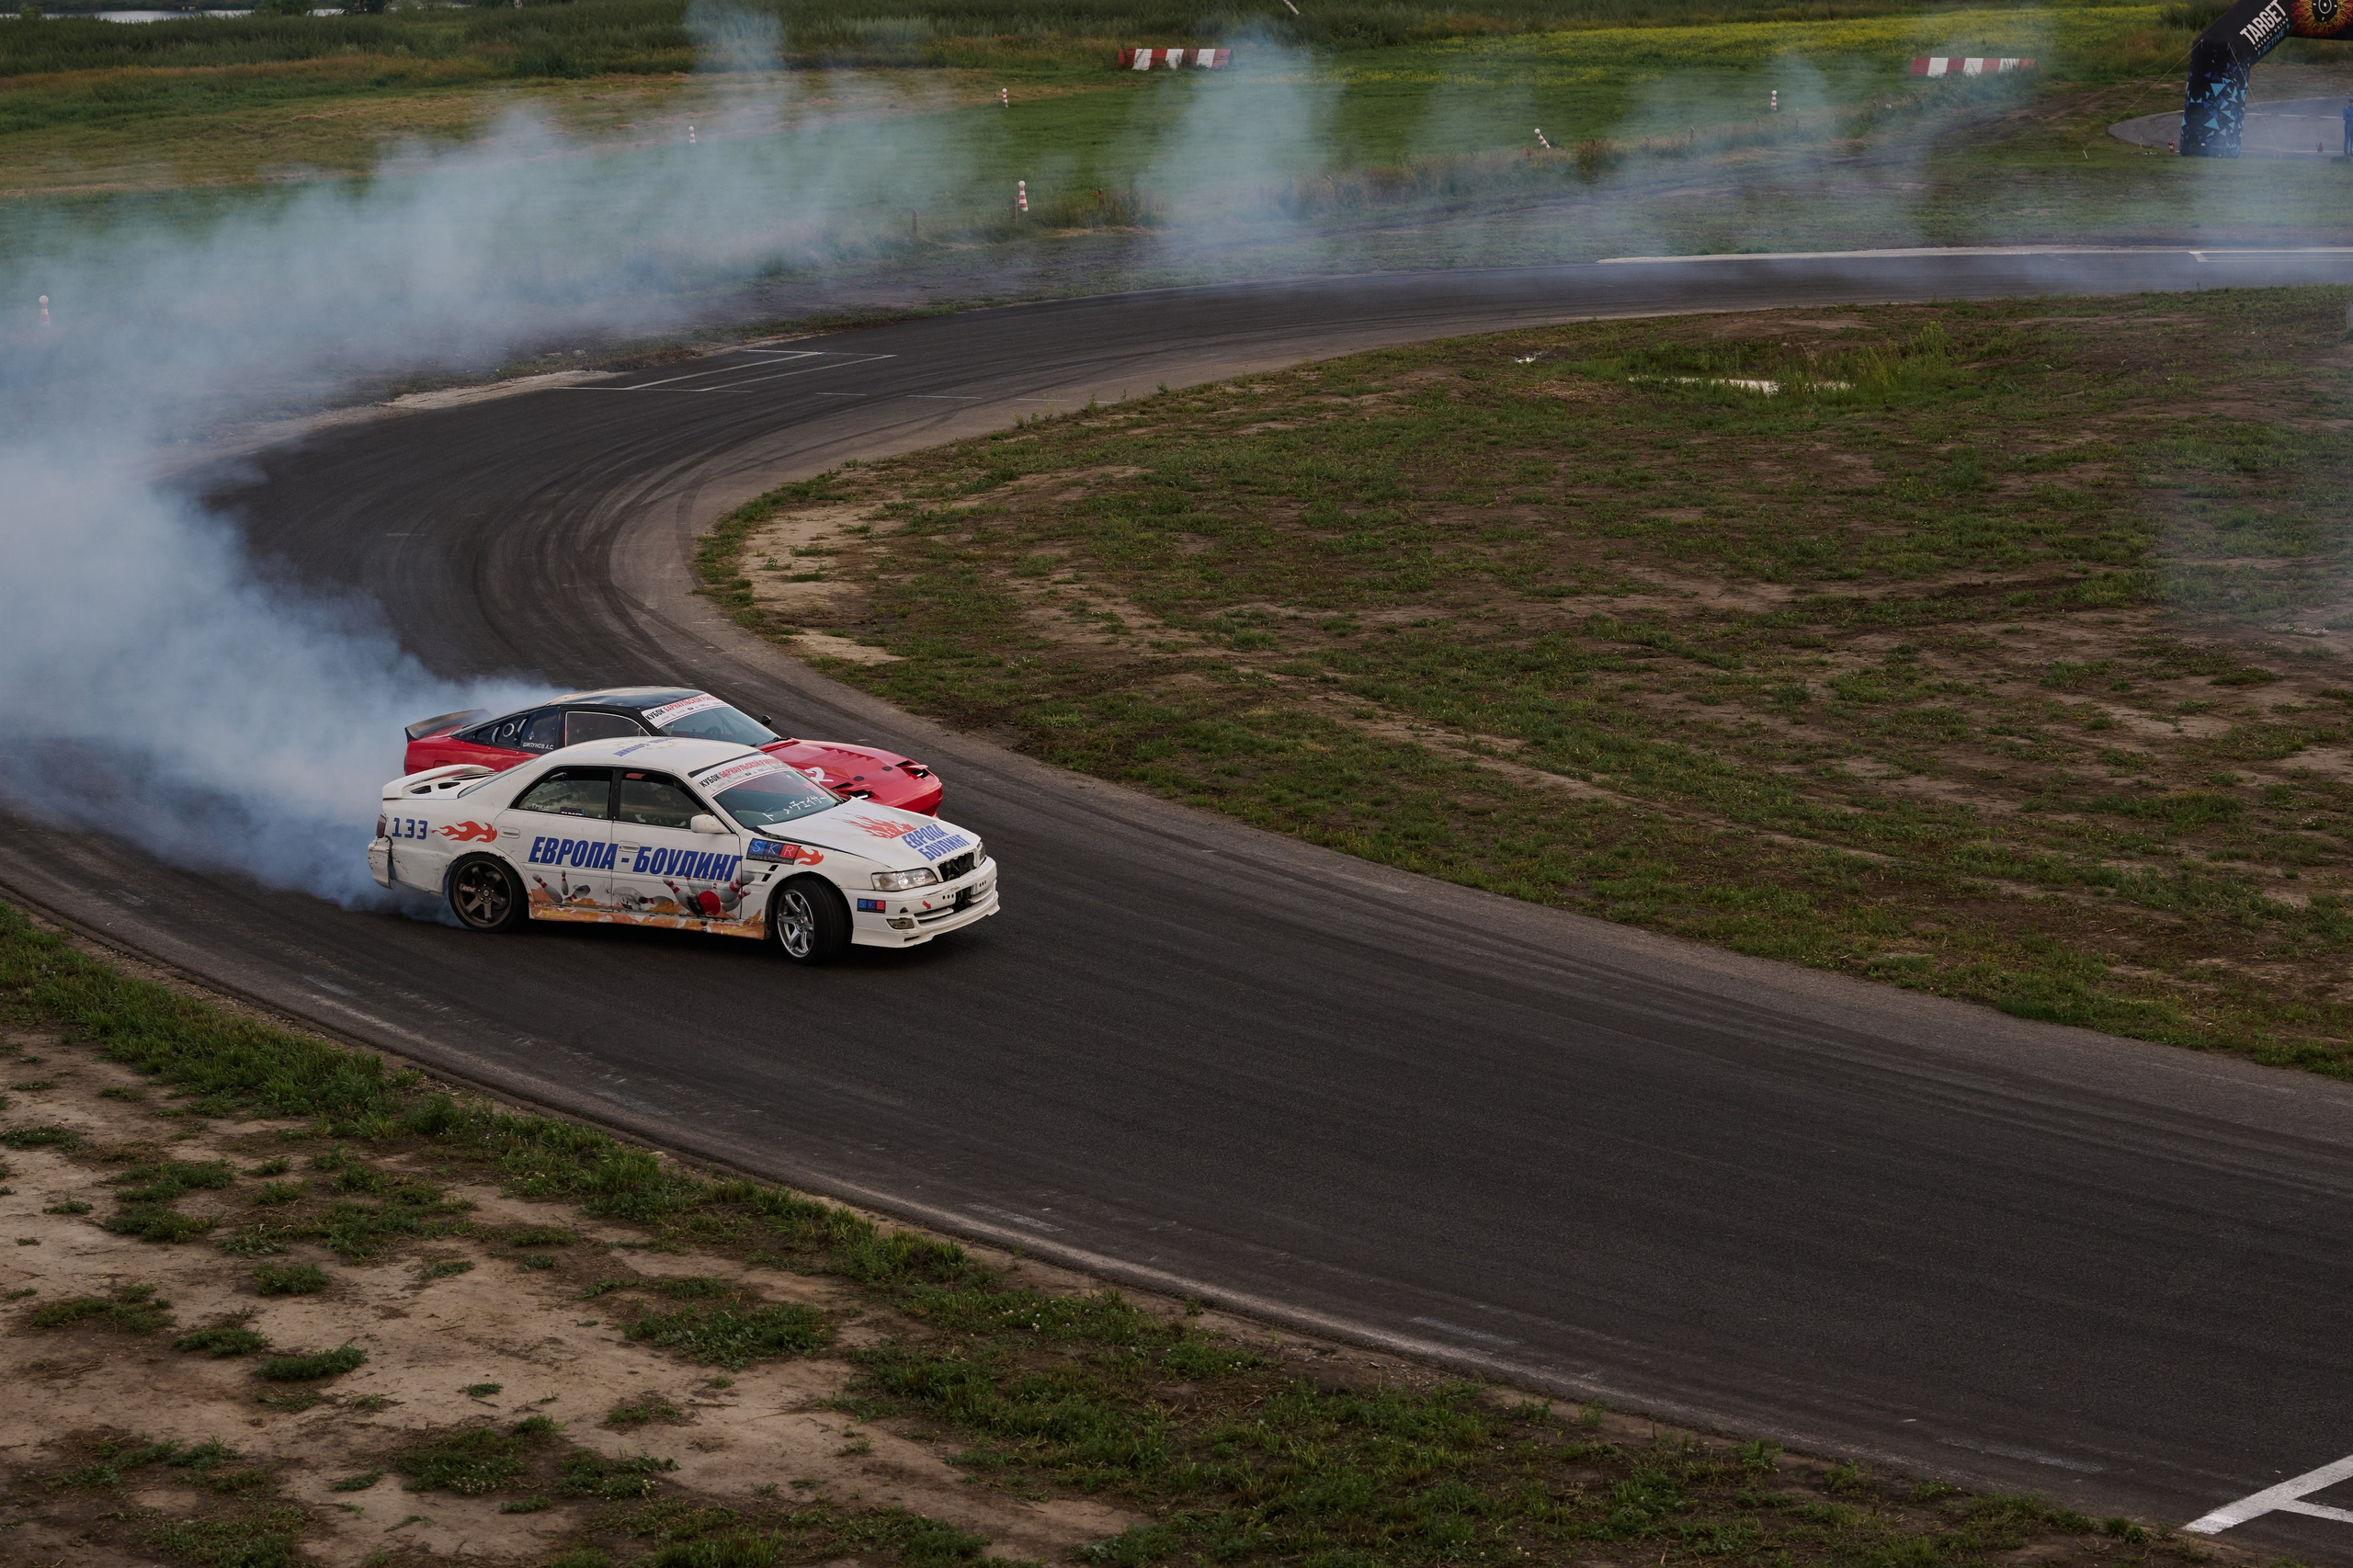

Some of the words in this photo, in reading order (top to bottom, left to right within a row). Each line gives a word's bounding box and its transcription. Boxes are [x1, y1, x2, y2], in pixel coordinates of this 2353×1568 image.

[2239, 0, 2287, 45] TARGET
[2262, 28, 2286, 54] ACTIVE
[645, 708, 666, 722] КУБОК
[699, 773, 722, 789] КУБОК
[392, 817, 428, 840] 133
[901, 824, 949, 849] ЕВРОПА
[528, 835, 619, 870] ЕВРОПА
[632, 846, 744, 882] БОУЛИНГ
[752, 840, 795, 857] SKR
[917, 834, 971, 862] БОУЛИНГ
[859, 901, 885, 910] SKR
